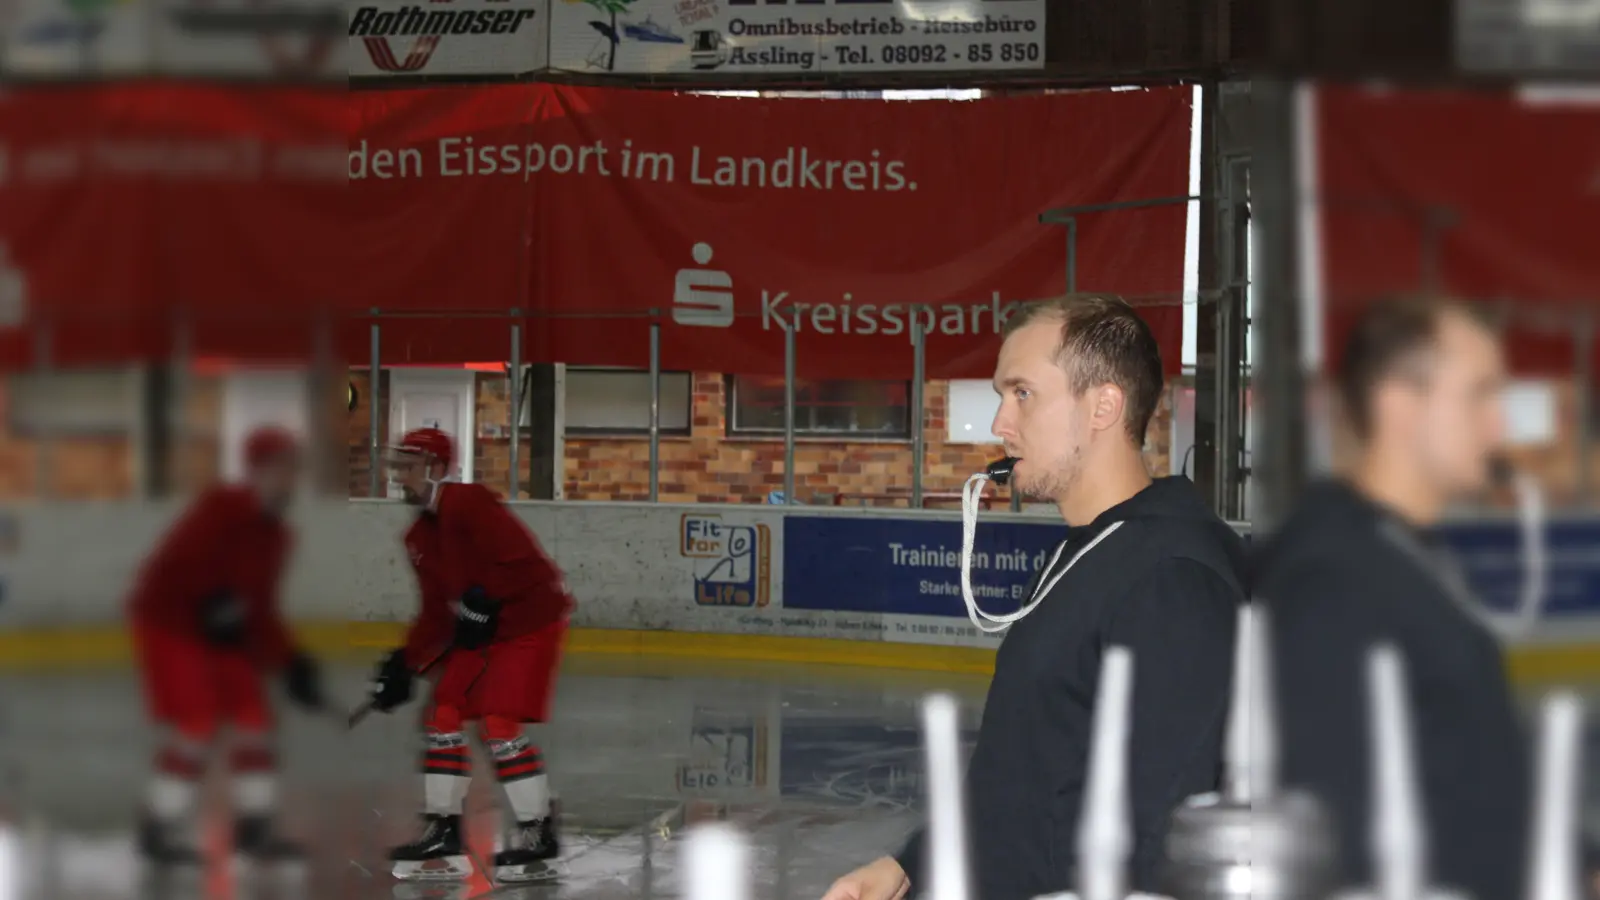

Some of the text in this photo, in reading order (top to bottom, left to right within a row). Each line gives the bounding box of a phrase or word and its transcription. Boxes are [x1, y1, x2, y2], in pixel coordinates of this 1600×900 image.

[349, 7, 535, 36] Rothmoser
[728, 17, 904, 36] Omnibusbetrieb
[728, 46, 815, 69] Assling
[835, 46, 874, 64] Tel.
[881, 44, 946, 63] 08092
[967, 44, 993, 62] 85
[1000, 42, 1039, 61] 850
[348, 136, 918, 191] den Eissport im Landkreis.
[761, 289, 1017, 346] Kreisspark
[686, 520, 721, 547] Fit
[995, 549, 1028, 572] mit
[919, 580, 959, 596] Starke
[964, 582, 1009, 599] artner:
